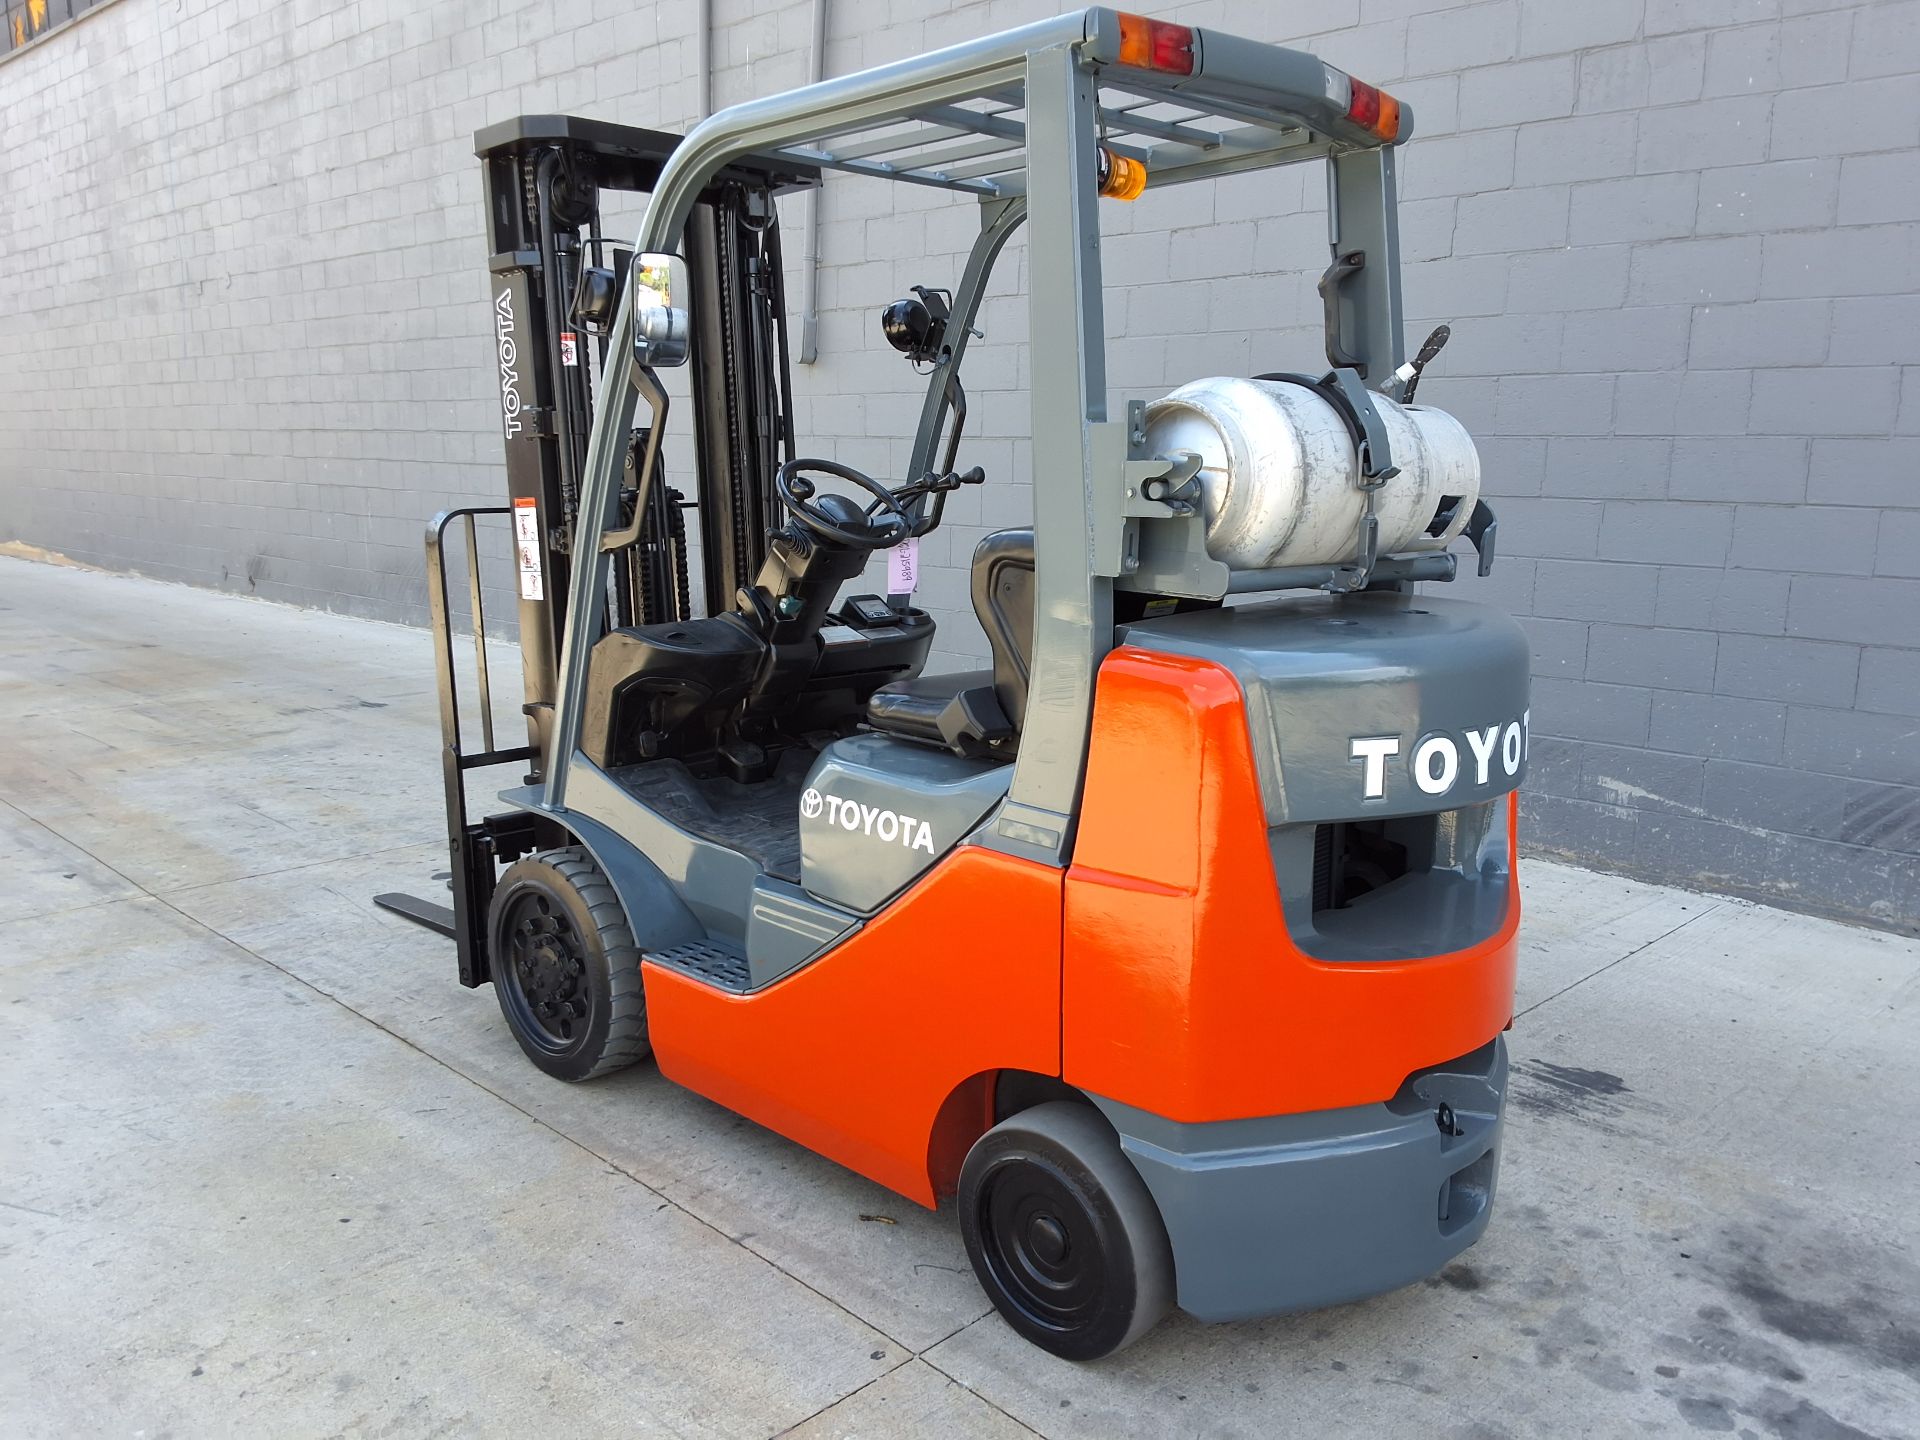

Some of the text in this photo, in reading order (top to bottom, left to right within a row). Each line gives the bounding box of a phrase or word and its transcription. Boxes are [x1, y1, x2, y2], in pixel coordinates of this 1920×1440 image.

[496, 287, 523, 440] TOYOTA
[1352, 708, 1530, 797] TOYOT
[826, 794, 935, 855] TOYOTA
